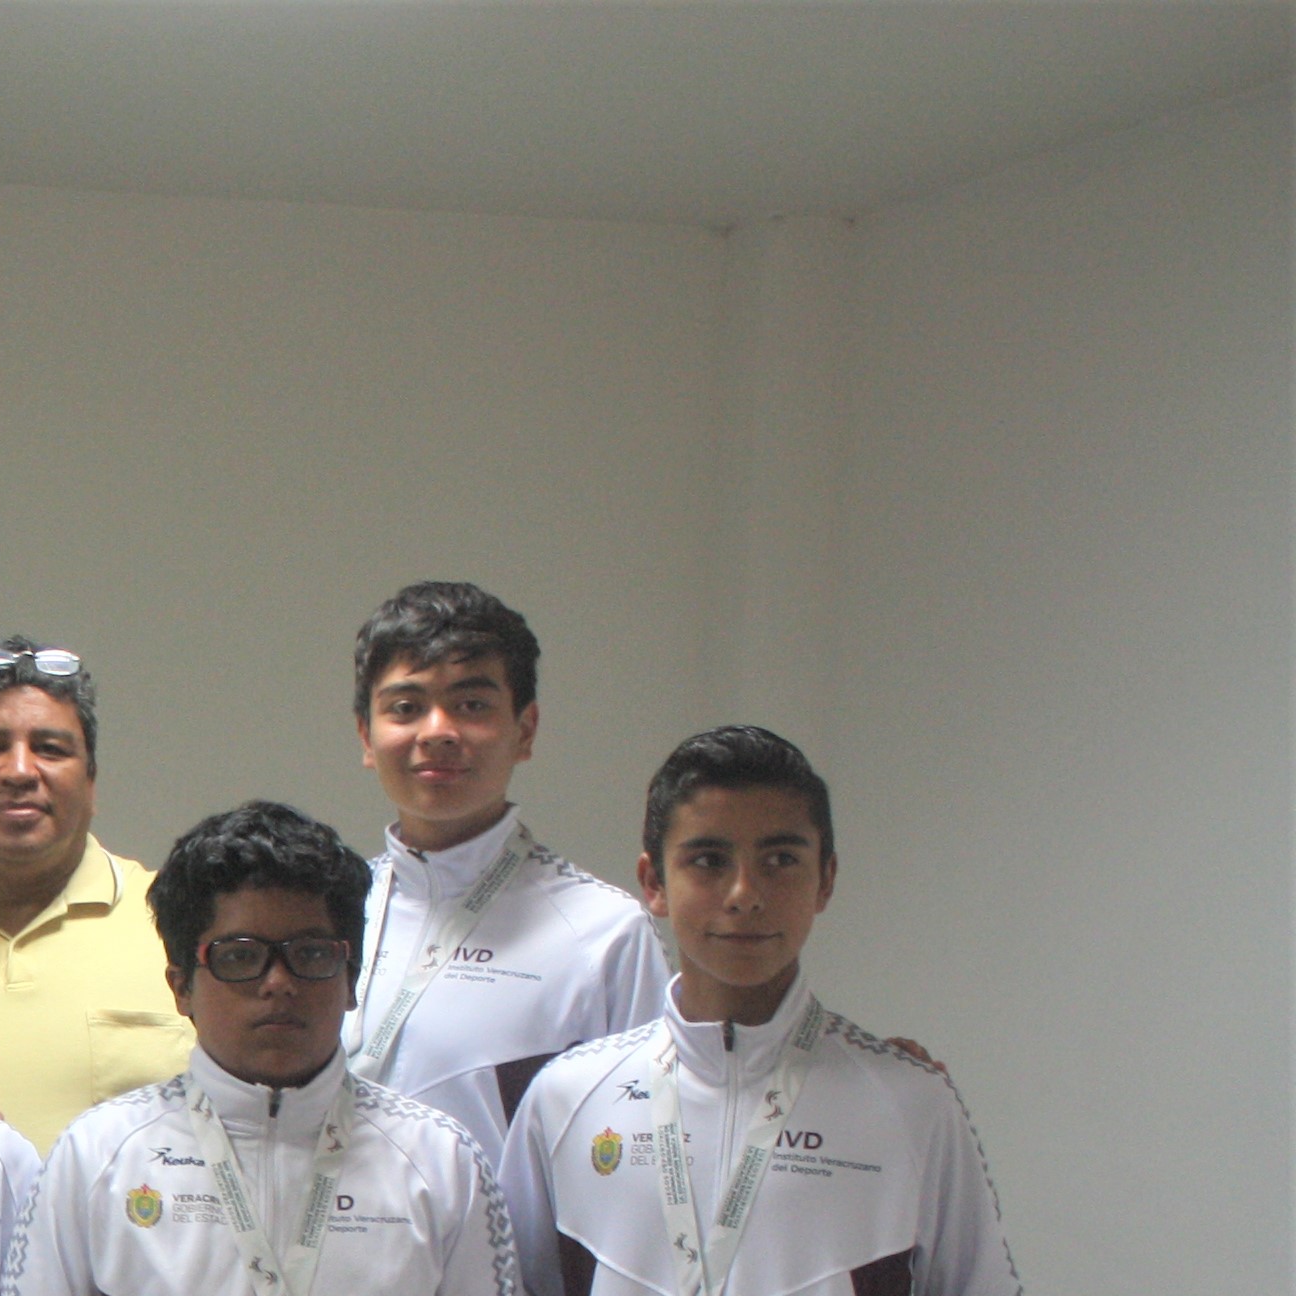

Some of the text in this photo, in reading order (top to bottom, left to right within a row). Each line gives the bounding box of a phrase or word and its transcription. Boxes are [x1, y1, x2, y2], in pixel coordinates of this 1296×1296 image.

[453, 947, 494, 963] IVD
[459, 974, 496, 984] Deporte
[776, 1130, 823, 1150] IVD
[162, 1156, 206, 1167] Keuka
[773, 1152, 882, 1173] Instituto Veracruzano
[771, 1164, 833, 1177] del Deporte
